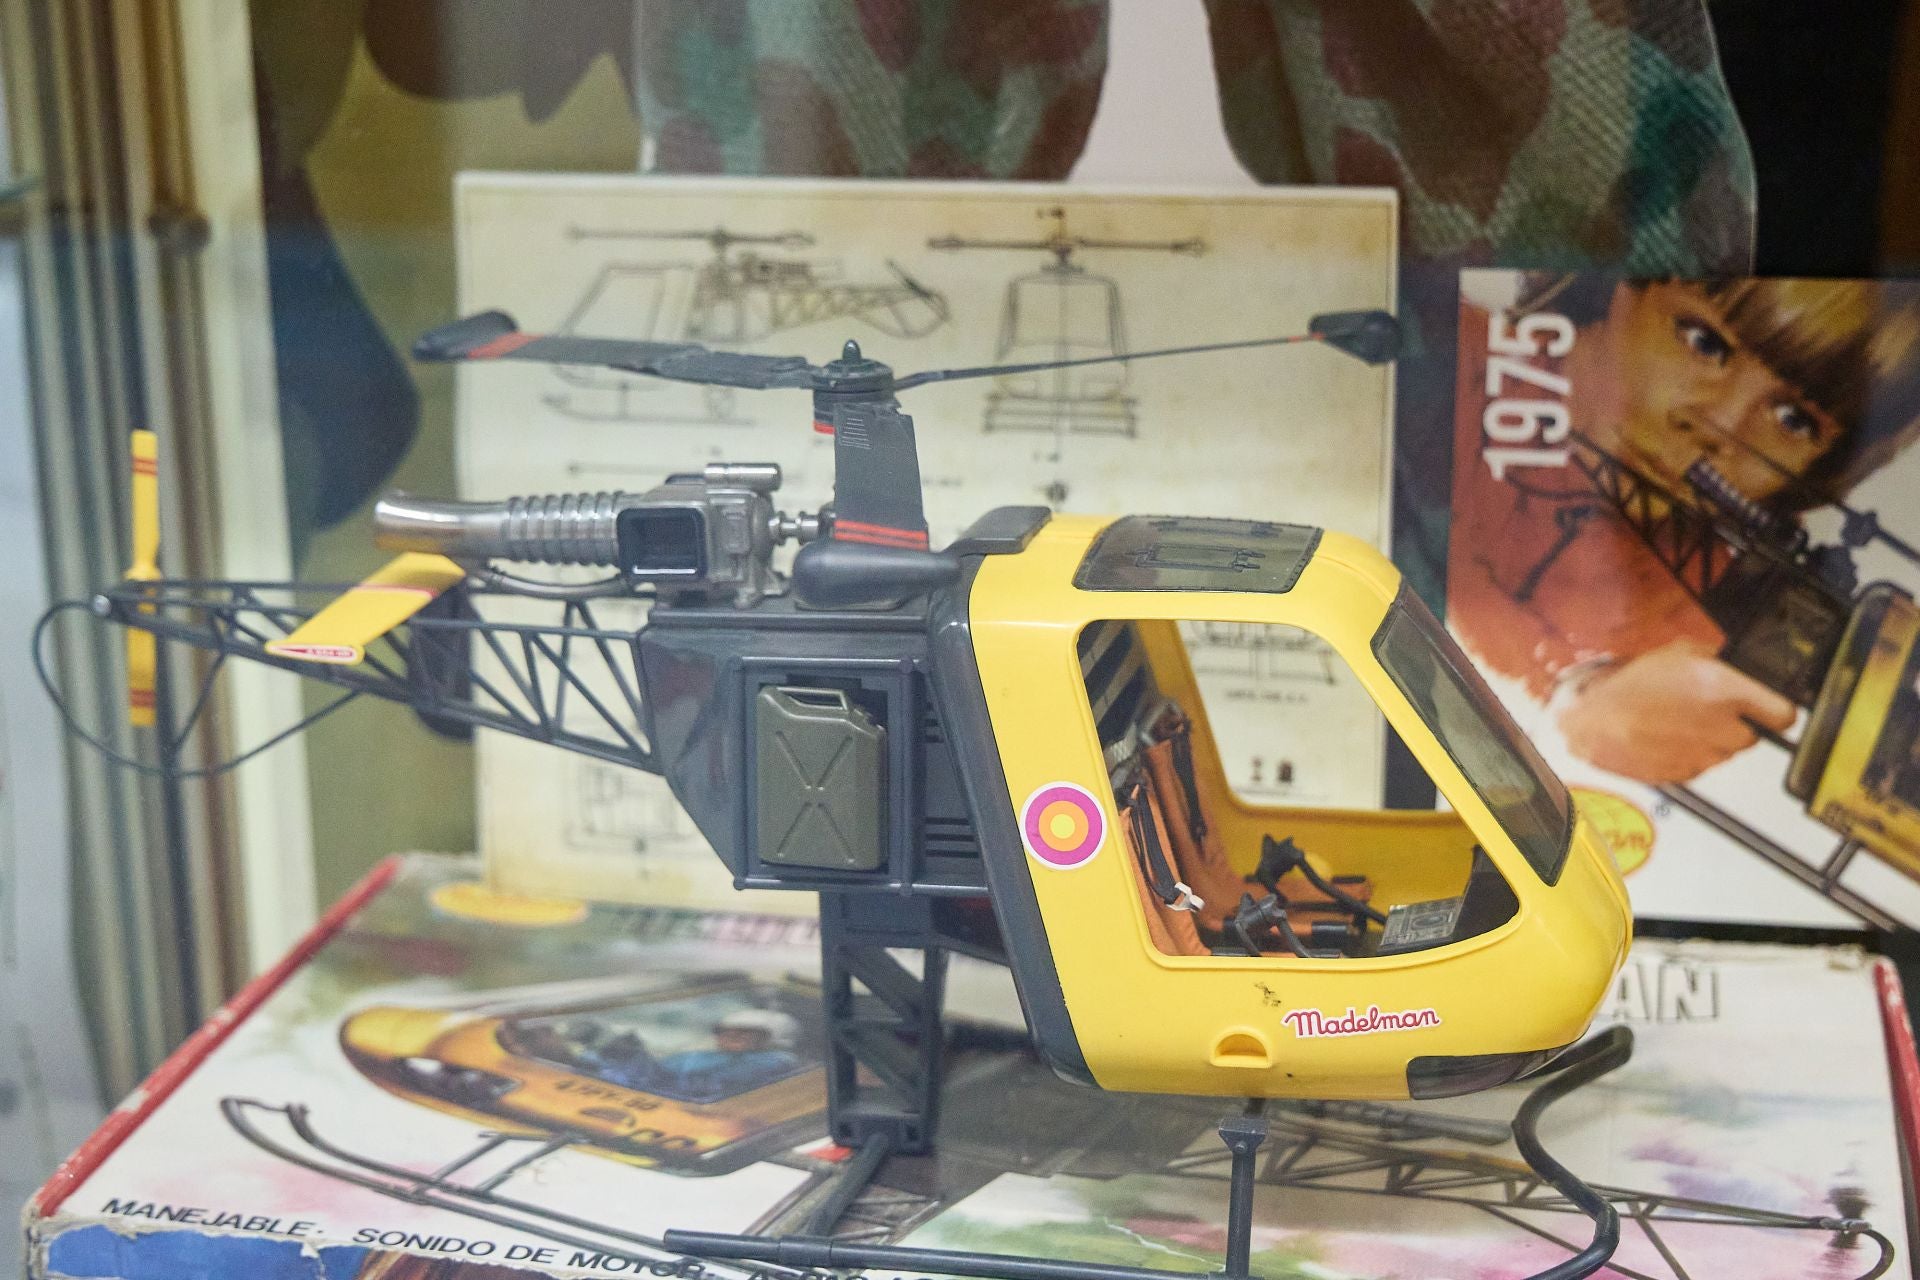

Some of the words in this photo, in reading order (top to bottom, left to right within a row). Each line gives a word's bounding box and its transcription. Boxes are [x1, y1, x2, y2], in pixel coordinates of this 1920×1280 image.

[1482, 312, 1576, 481] 1975
[1284, 1006, 1440, 1036] Madelman
[352, 1227, 497, 1257] SONIDO
[504, 1244, 560, 1264] DE
